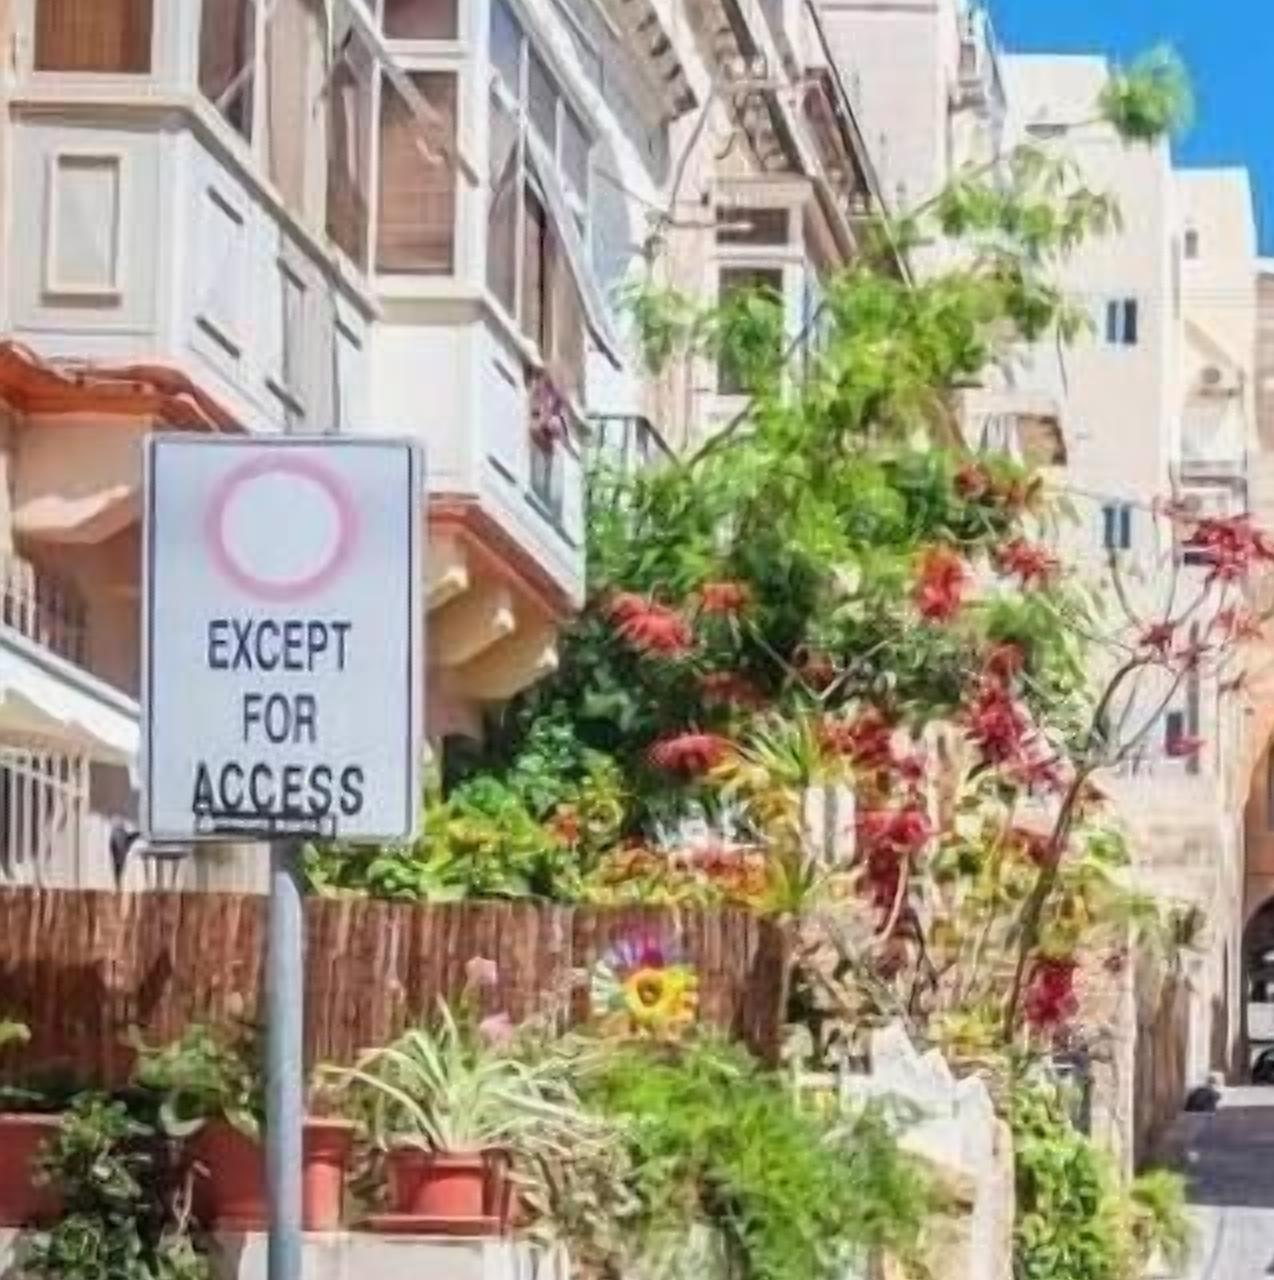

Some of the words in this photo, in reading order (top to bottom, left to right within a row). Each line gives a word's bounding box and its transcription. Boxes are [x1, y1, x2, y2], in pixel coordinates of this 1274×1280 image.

[208, 618, 351, 671] EXCEPT
[243, 693, 317, 743] FOR
[192, 762, 365, 816] ACCESS
